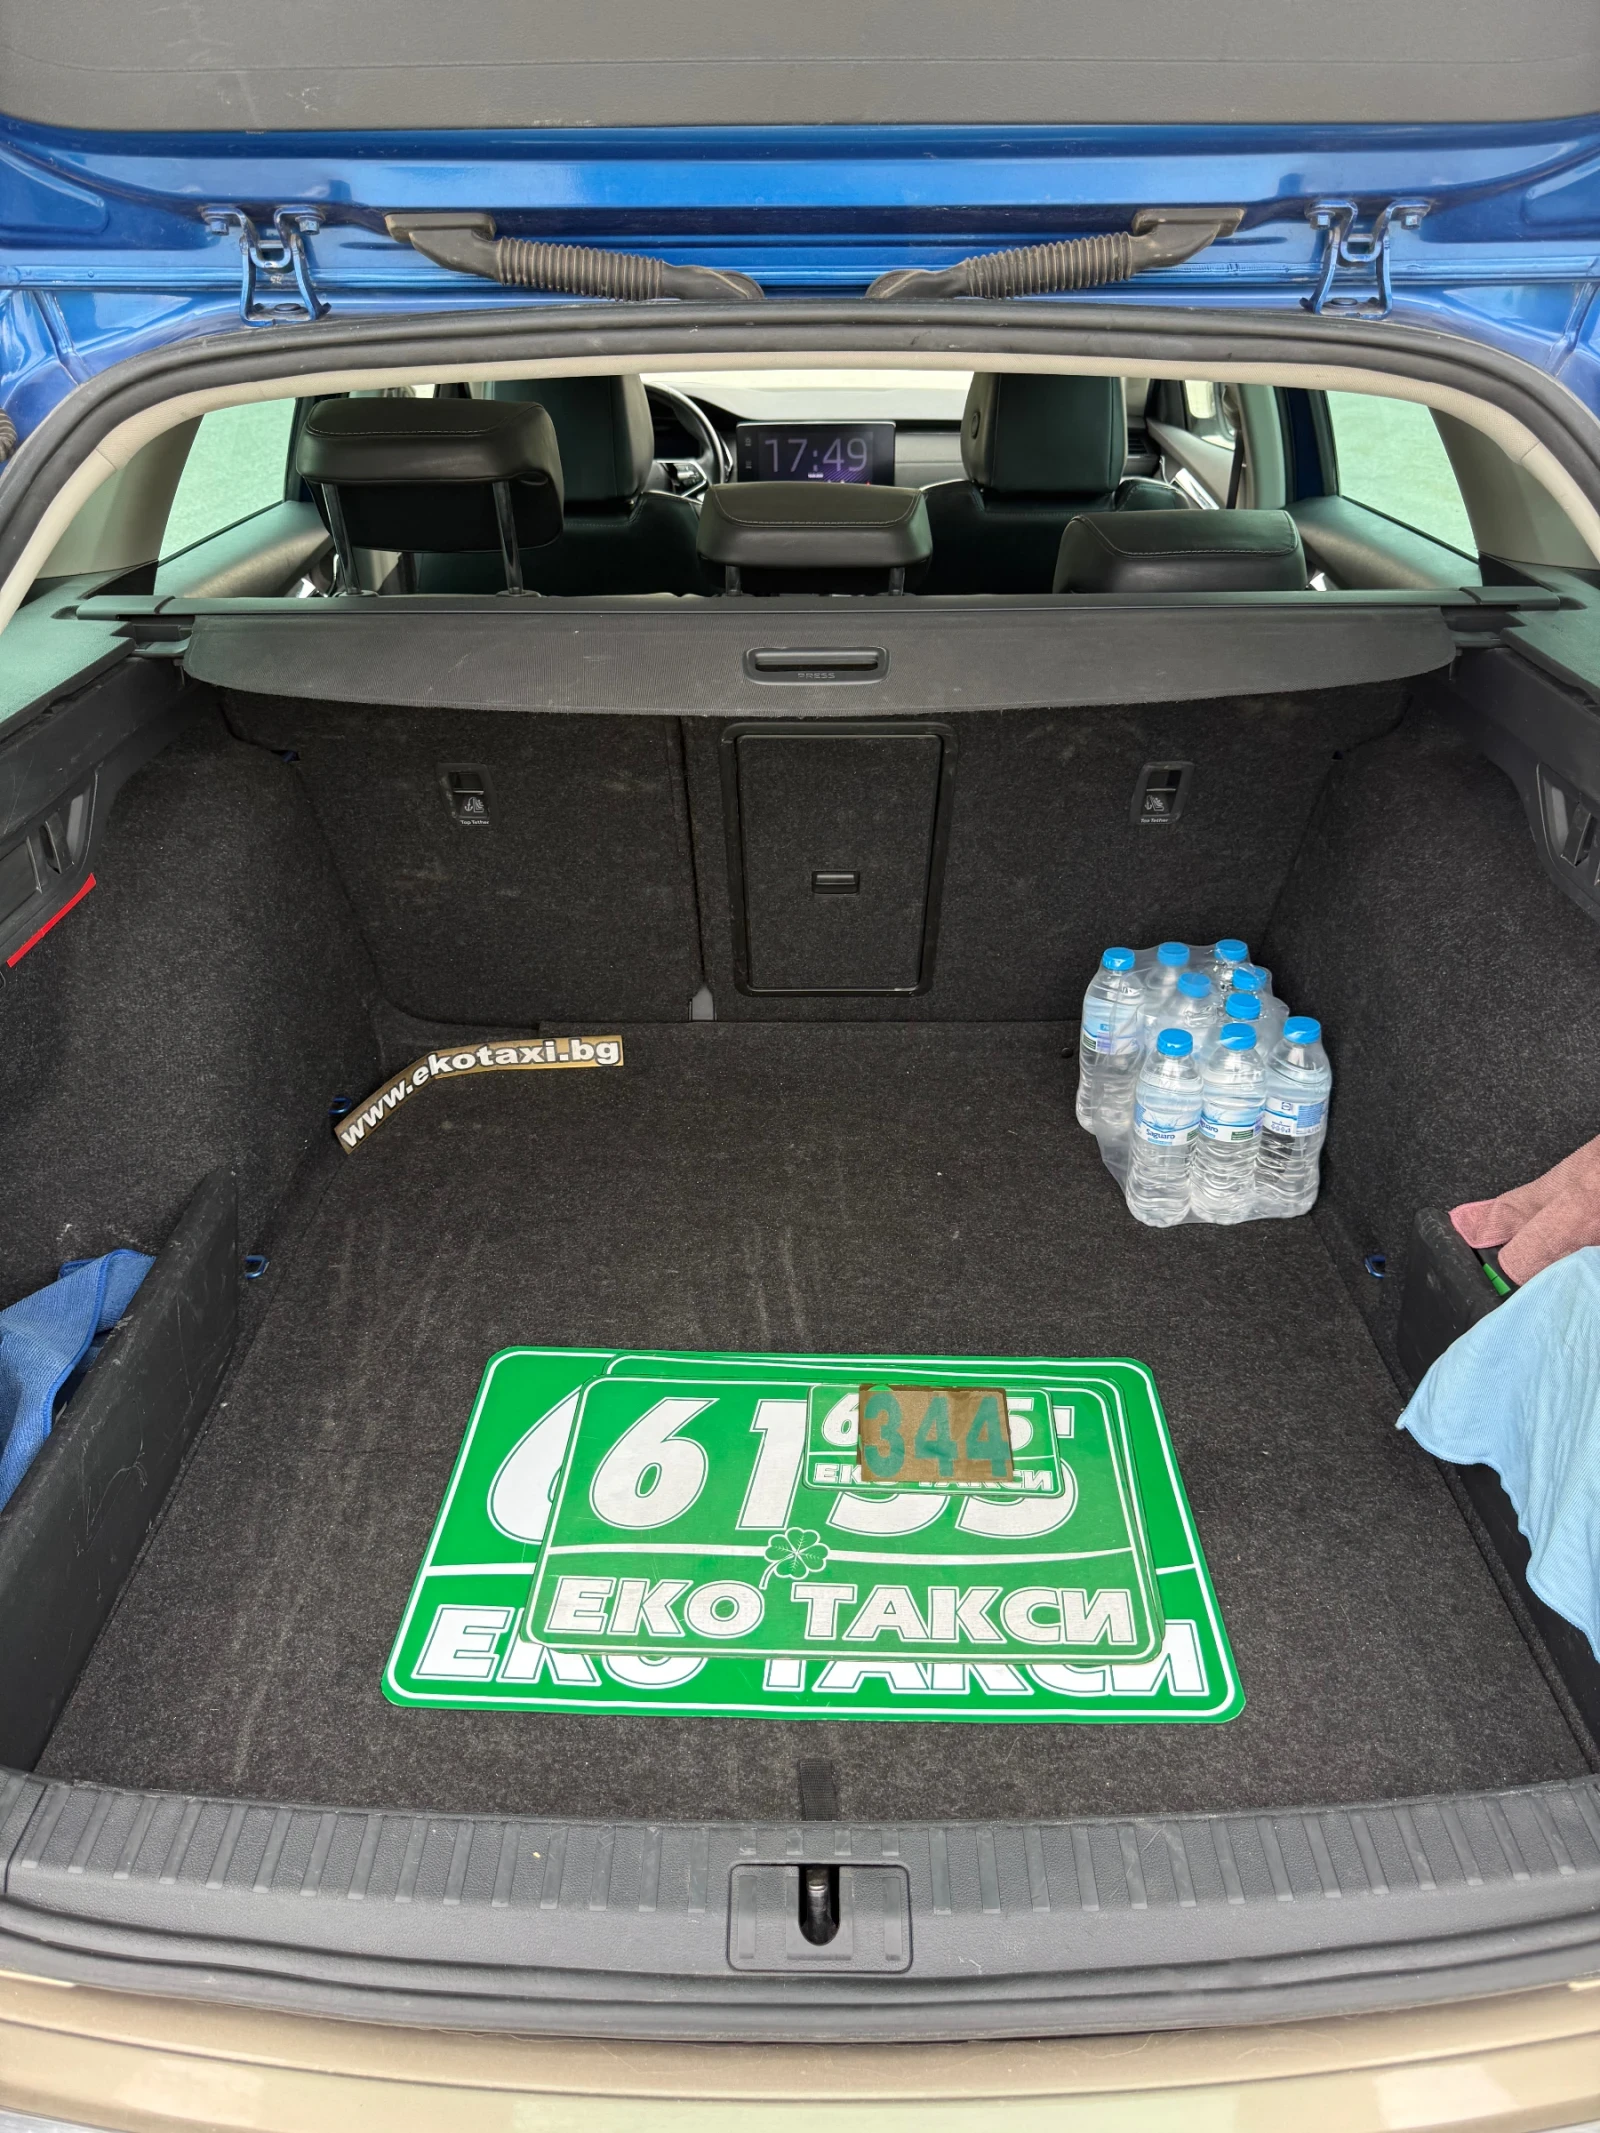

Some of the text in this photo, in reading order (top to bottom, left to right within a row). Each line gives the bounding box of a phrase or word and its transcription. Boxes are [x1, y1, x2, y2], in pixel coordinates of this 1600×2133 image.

[765, 438, 868, 473] 17:49
[797, 671, 836, 679] PRESS
[340, 1038, 621, 1149] www.ekotaxi.bg
[1146, 1128, 1176, 1140] Saguaro
[864, 1392, 1011, 1478] 344
[544, 1577, 1138, 1645] ЕКО ТАКСИ
